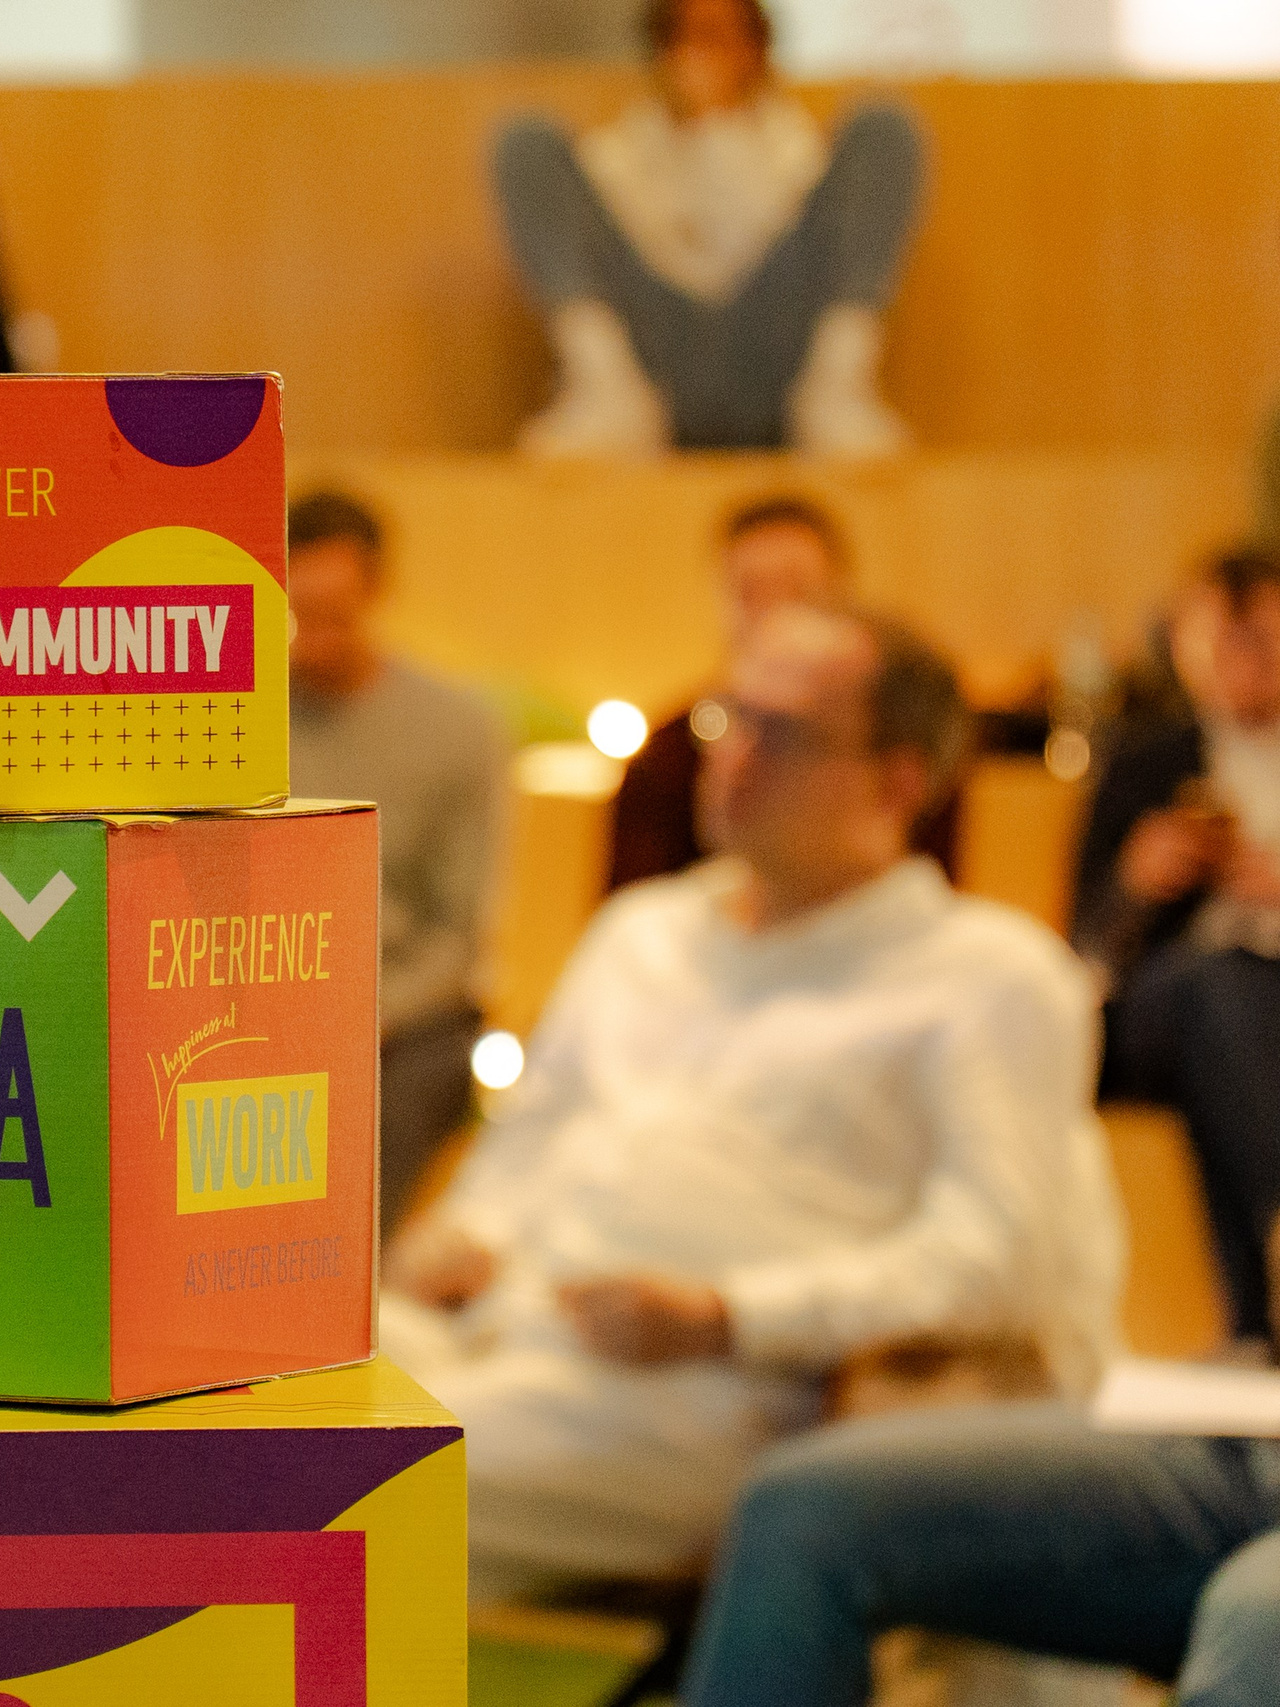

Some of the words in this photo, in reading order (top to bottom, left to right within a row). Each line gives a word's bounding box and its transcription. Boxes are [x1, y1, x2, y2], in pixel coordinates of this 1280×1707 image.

[147, 912, 332, 989] EXPERIENCE
[161, 1014, 221, 1078] happiness
[222, 1002, 237, 1029] at
[185, 1089, 315, 1194] WORK
[183, 1252, 209, 1298] AS
[213, 1245, 271, 1293] NEVER
[277, 1235, 343, 1285] BEFORE
